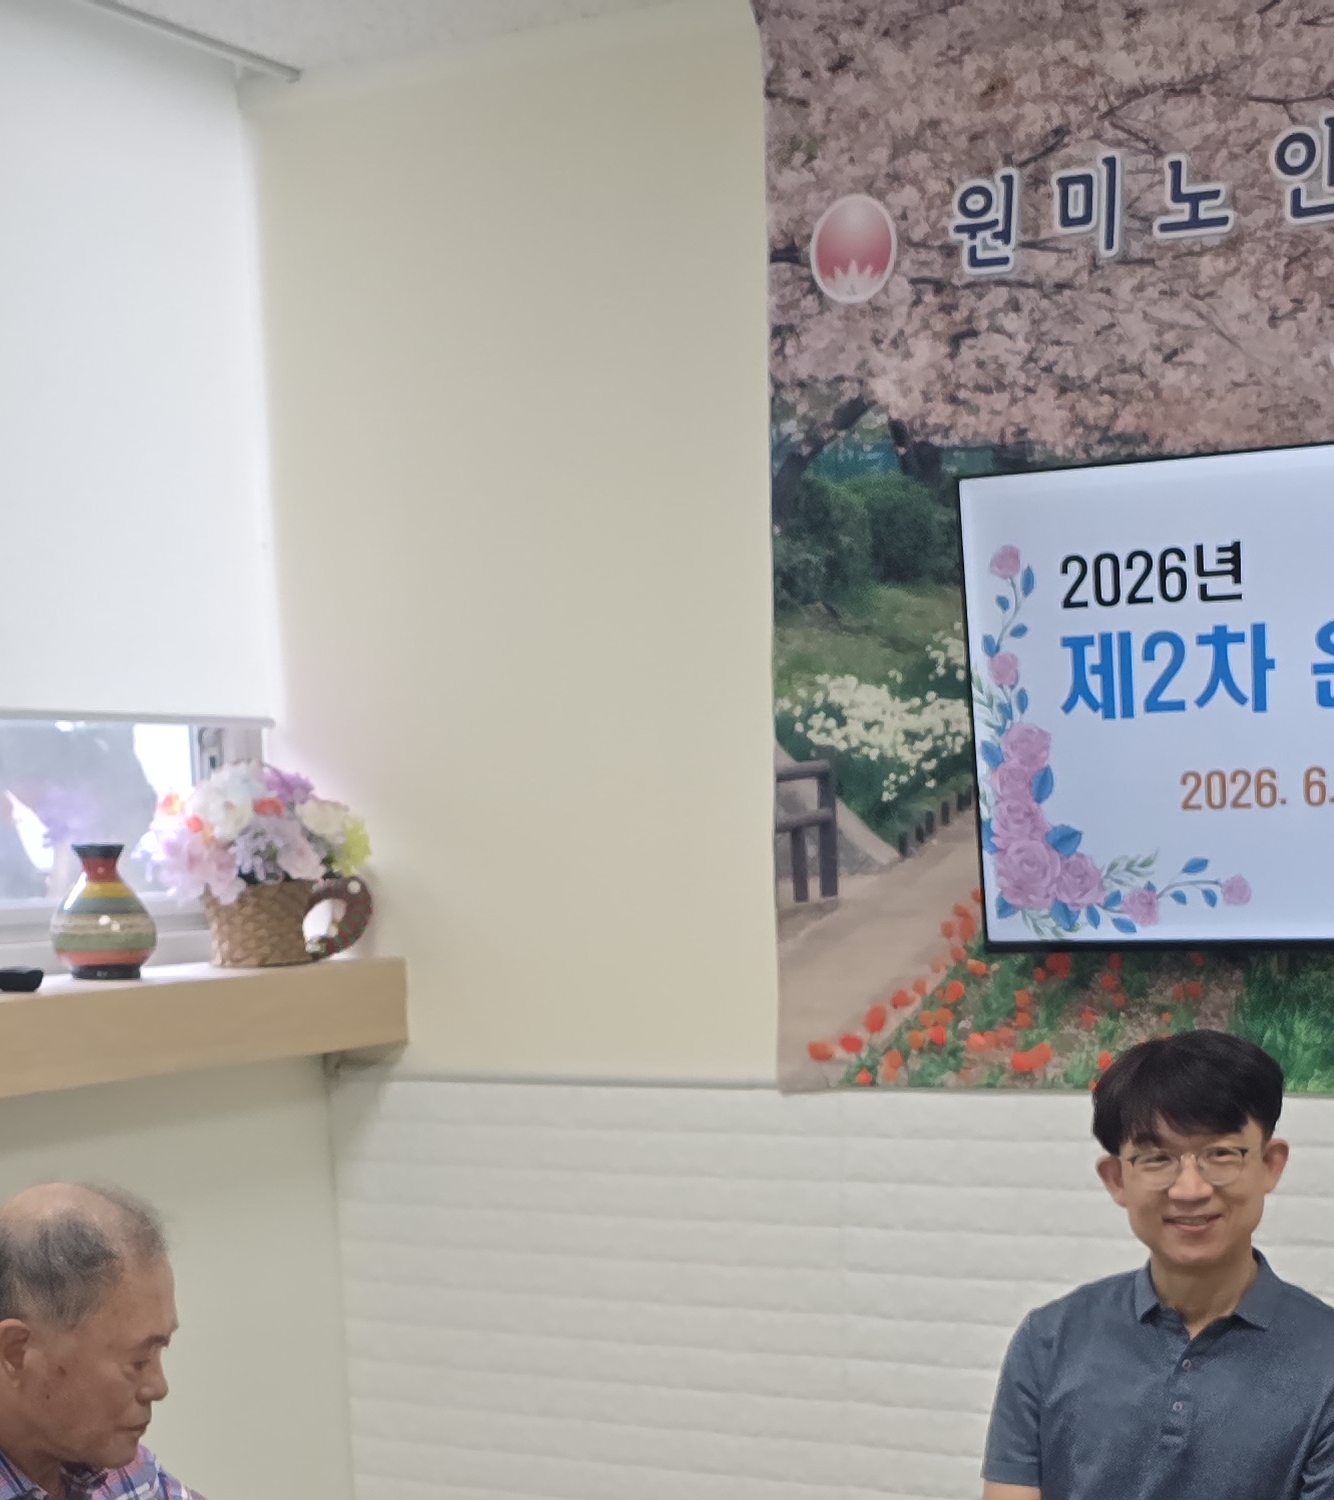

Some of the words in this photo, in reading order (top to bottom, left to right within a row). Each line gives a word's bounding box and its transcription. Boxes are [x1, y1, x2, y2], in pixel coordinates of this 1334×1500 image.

[1060, 540, 1244, 611] 2026년
[1060, 621, 1276, 722] 제2차
[1180, 767, 1287, 811] 2026.
